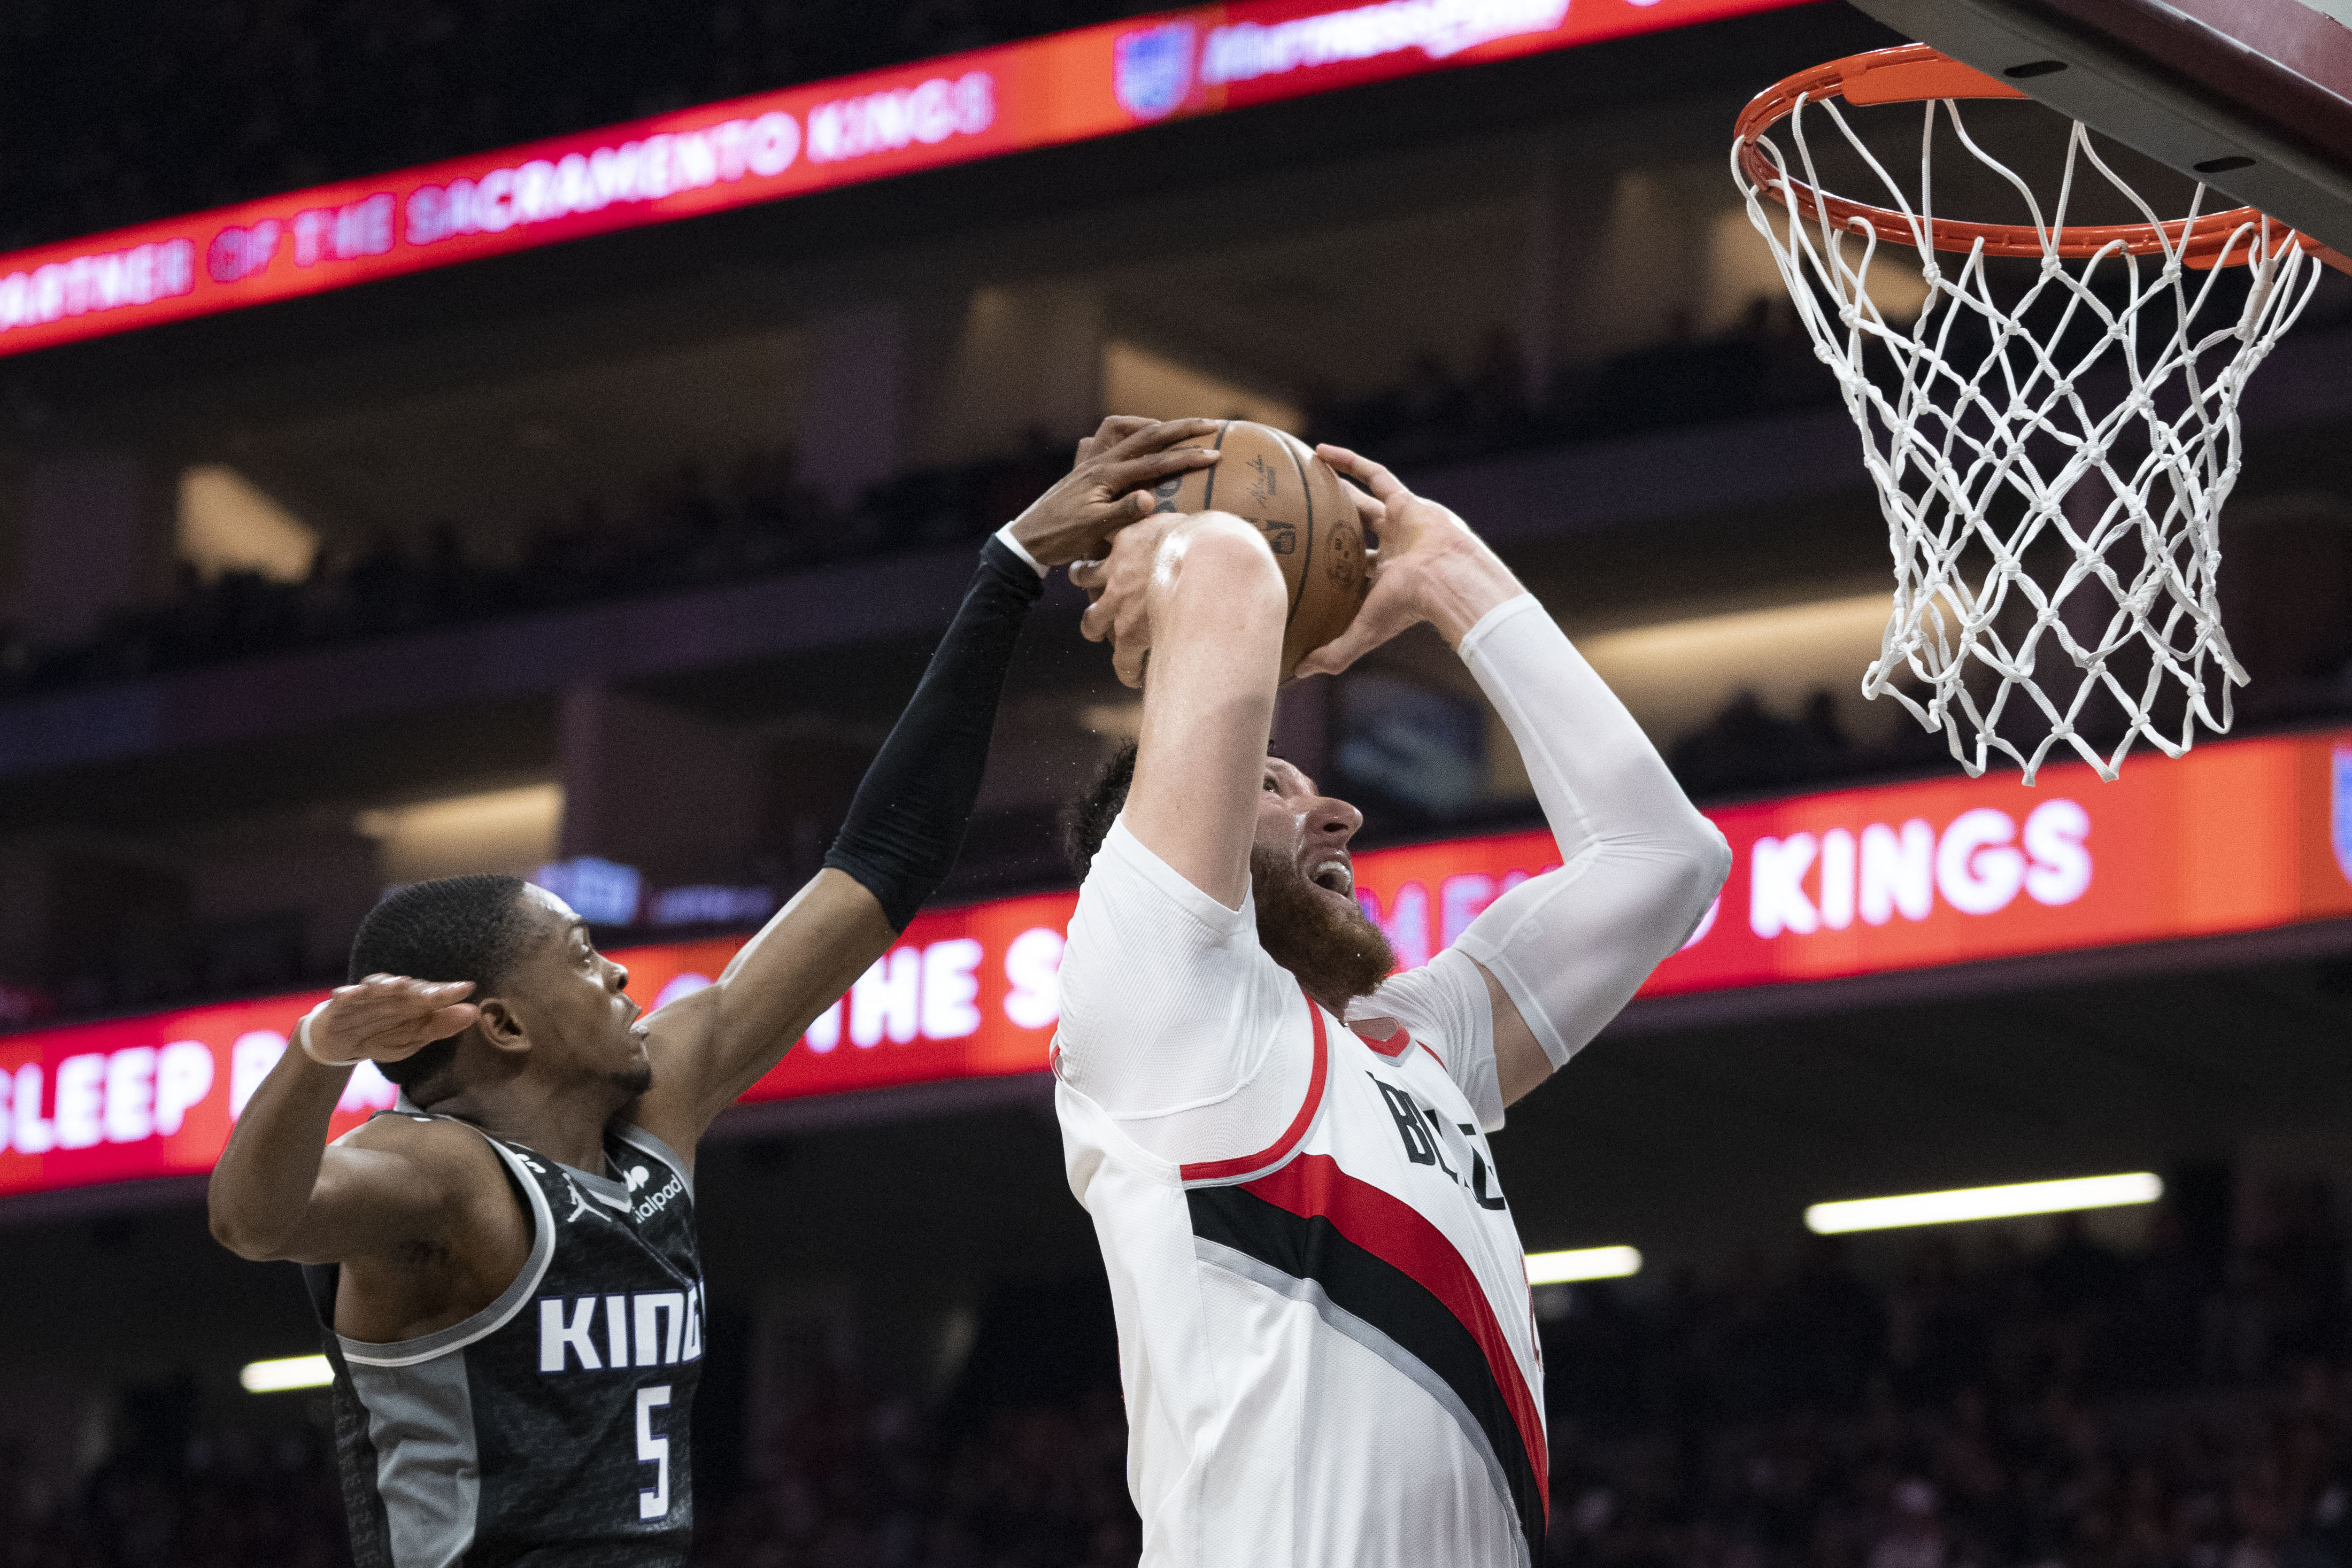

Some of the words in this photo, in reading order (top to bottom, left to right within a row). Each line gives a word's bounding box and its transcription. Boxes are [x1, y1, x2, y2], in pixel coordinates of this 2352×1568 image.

[405, 110, 801, 246] SACRAMENTO
[806, 69, 998, 164] KINGS
[1749, 798, 2093, 940] KINGS
[0, 1040, 215, 1155] LEEP
[633, 1174, 683, 1224] ialpad
[636, 1385, 672, 1523] 5
